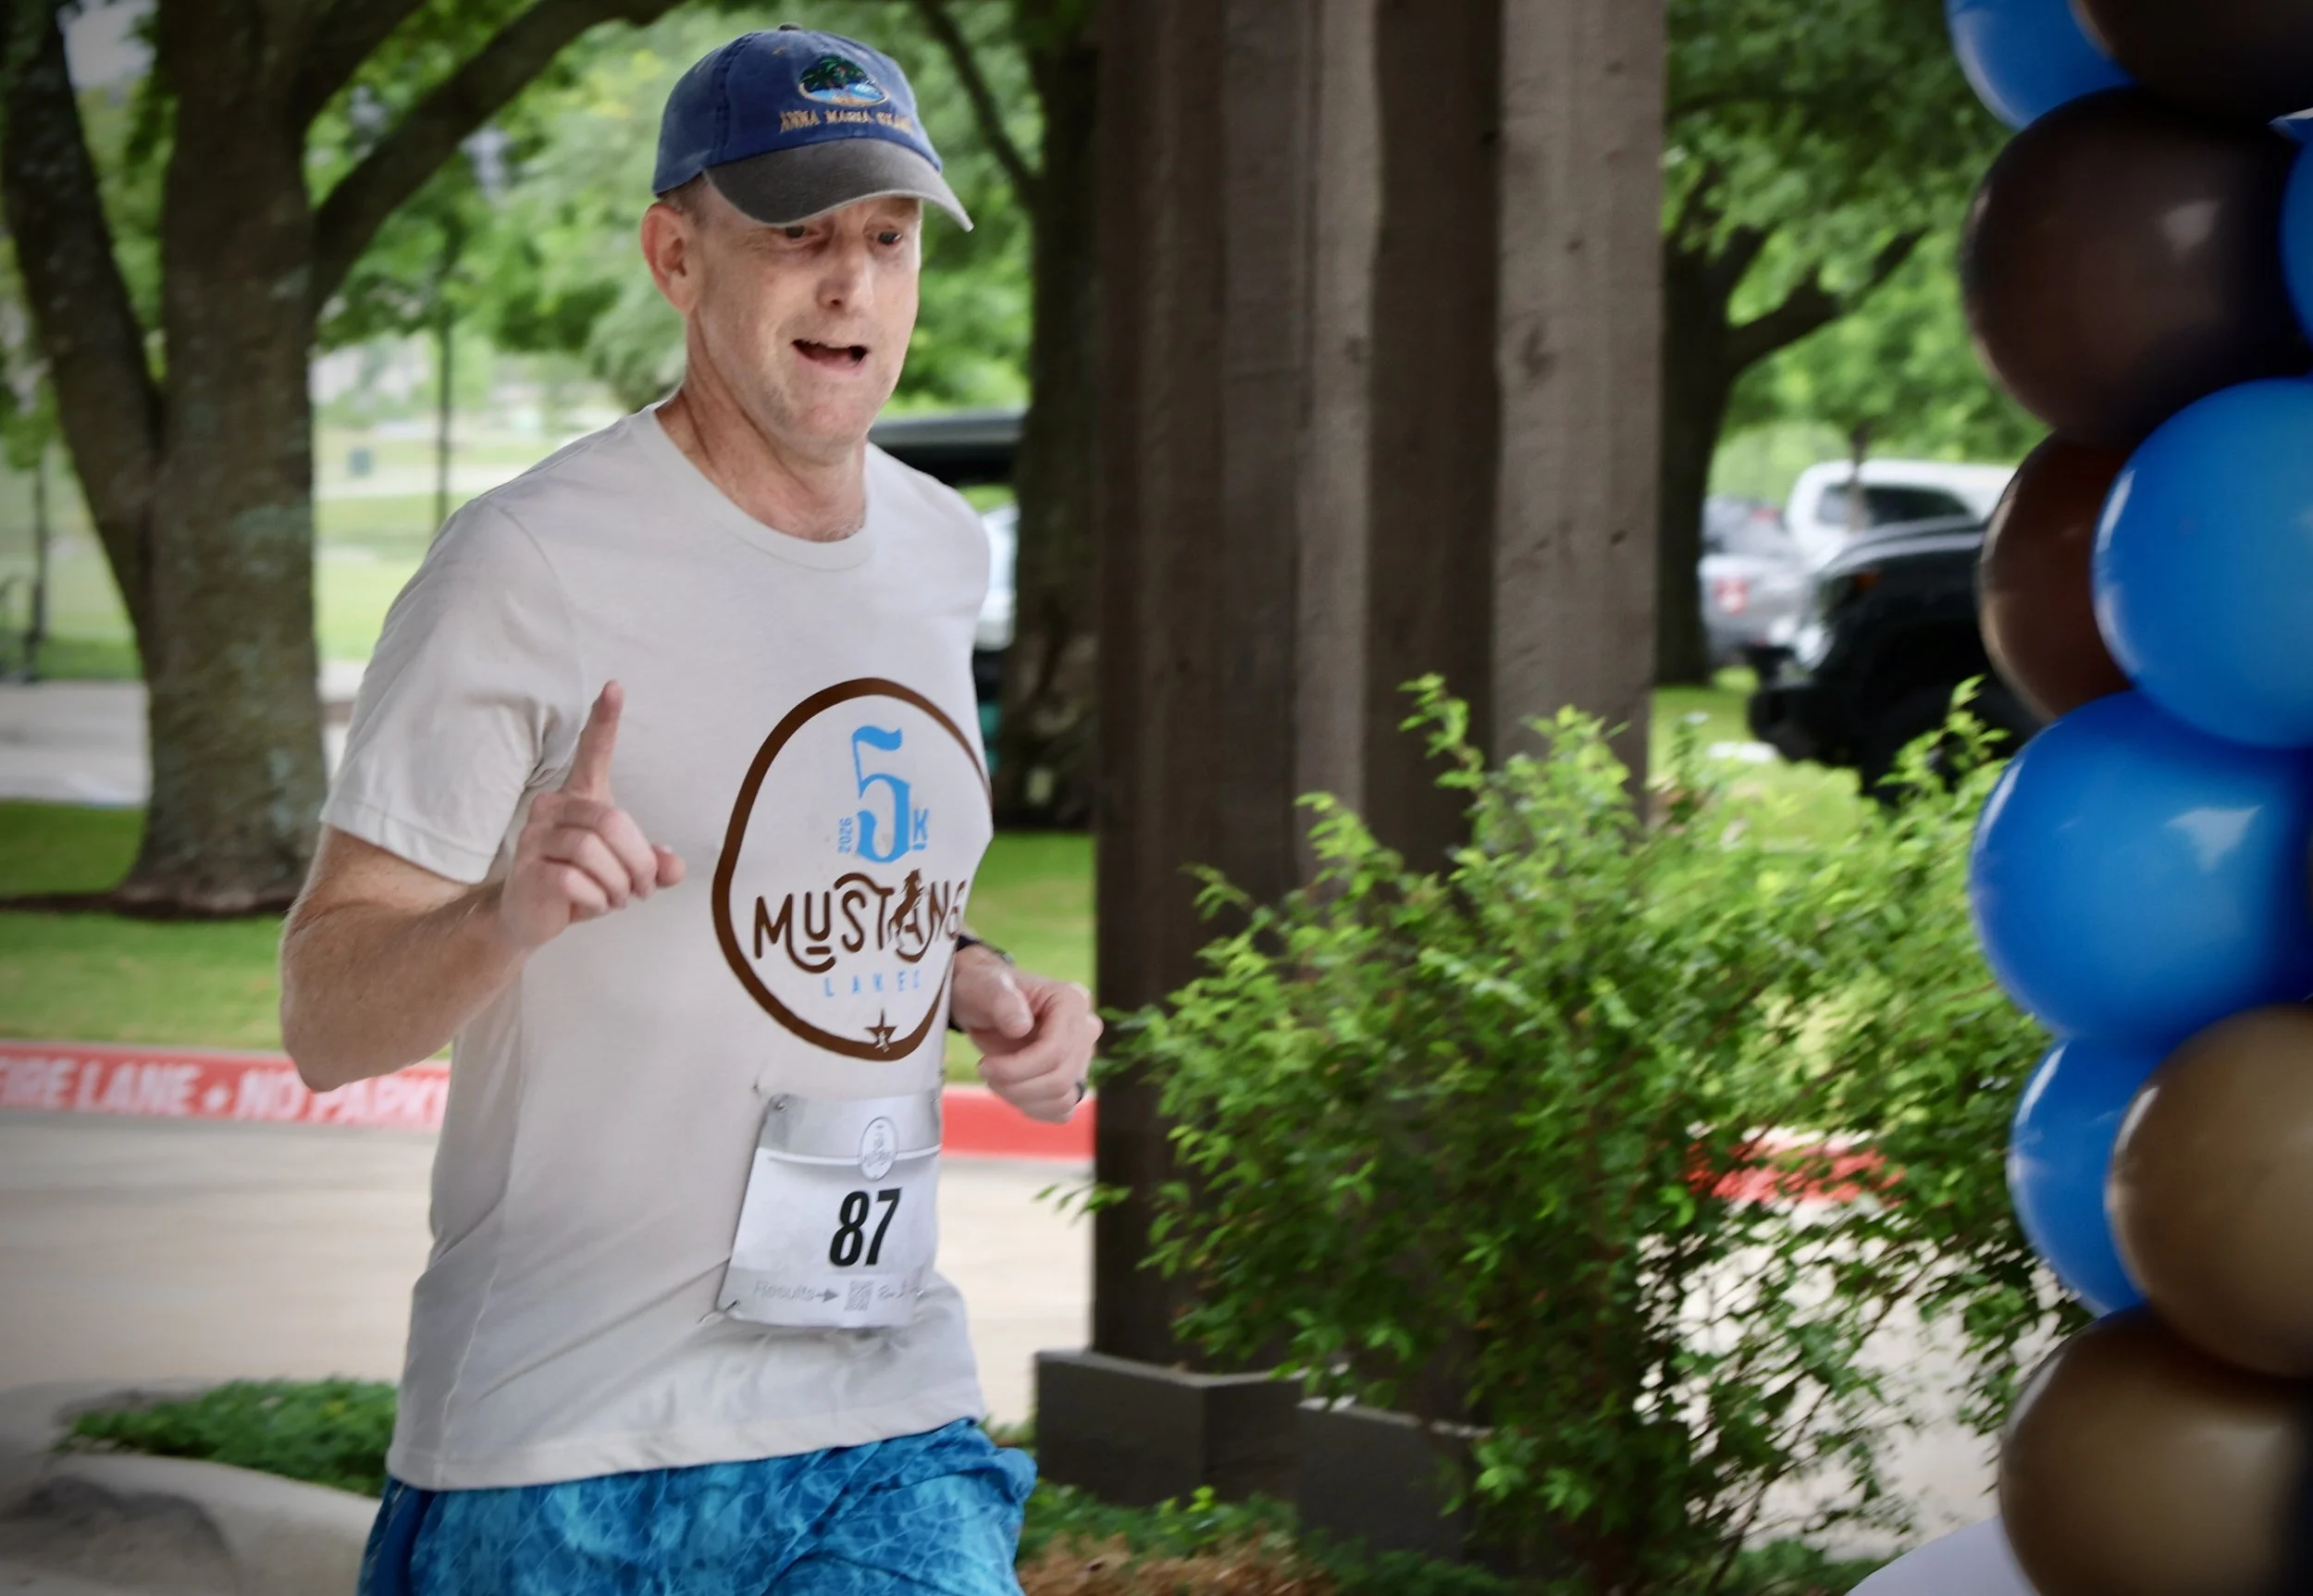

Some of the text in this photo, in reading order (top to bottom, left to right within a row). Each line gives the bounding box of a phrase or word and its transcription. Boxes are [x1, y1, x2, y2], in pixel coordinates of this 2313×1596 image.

[754, 869, 968, 973] MUSTANG
[77, 1059, 201, 1117] LANE
[234, 1069, 301, 1122] NO
[828, 1187, 903, 1268] 87
